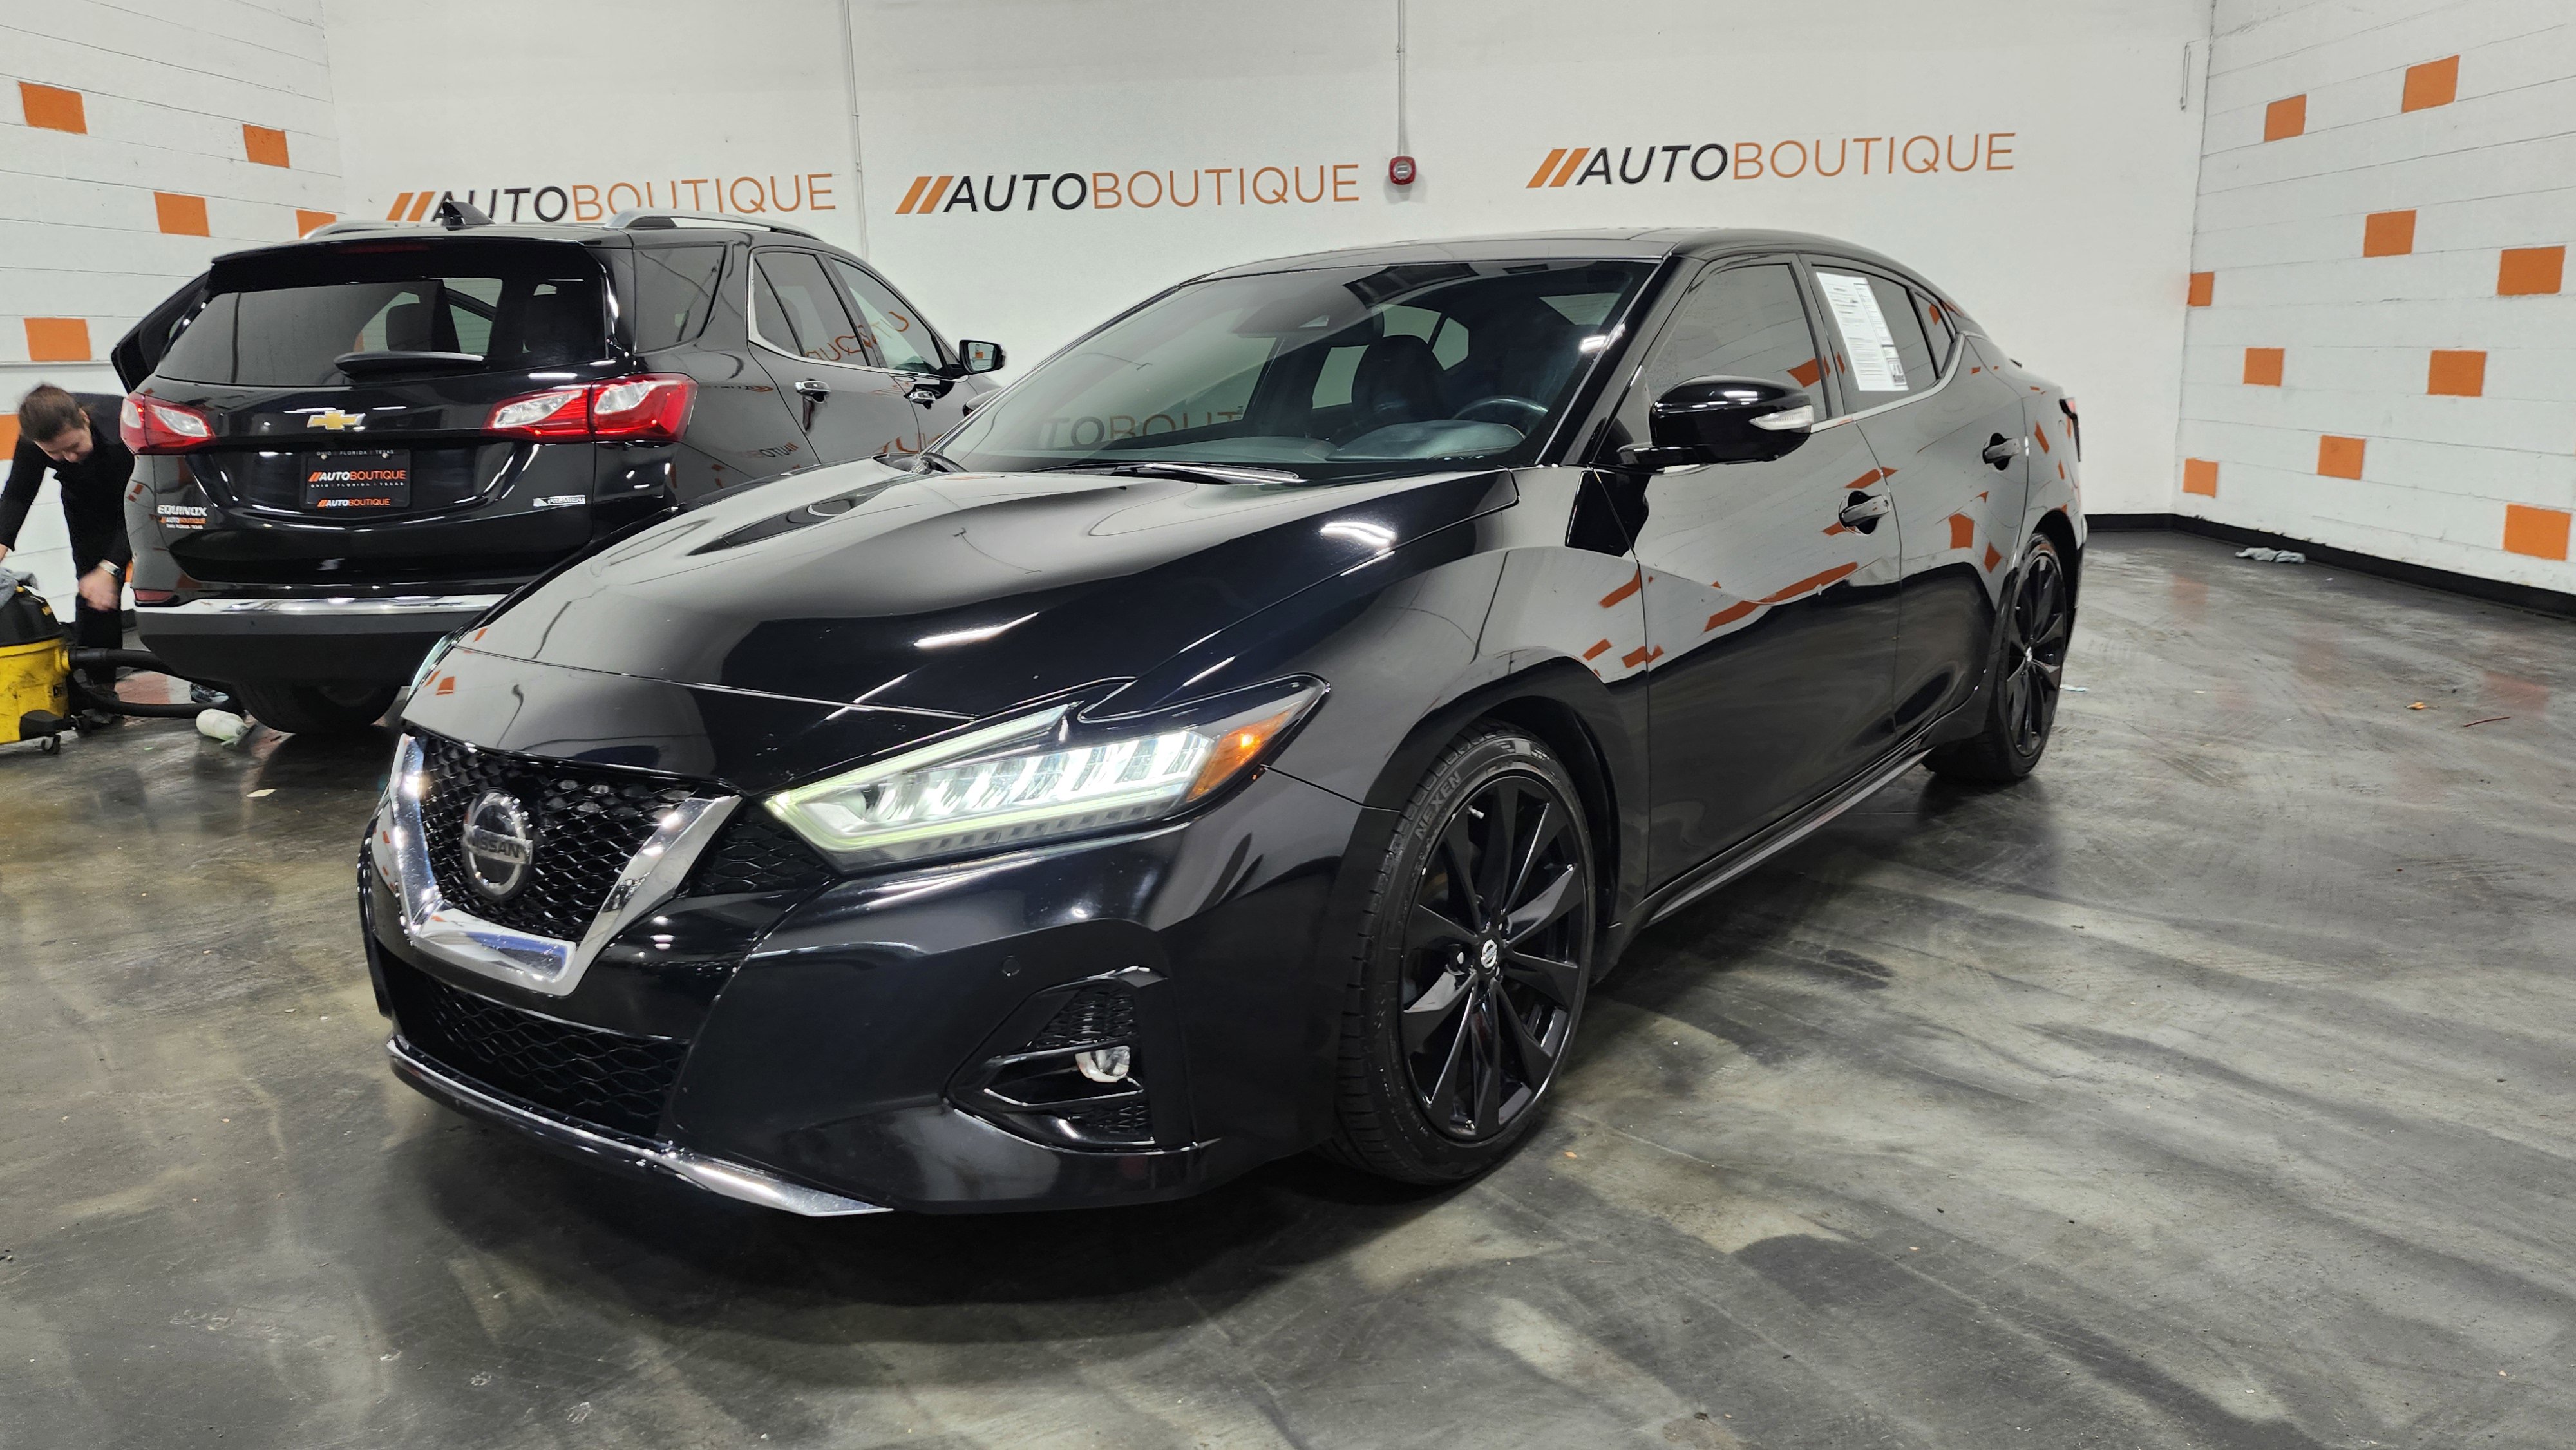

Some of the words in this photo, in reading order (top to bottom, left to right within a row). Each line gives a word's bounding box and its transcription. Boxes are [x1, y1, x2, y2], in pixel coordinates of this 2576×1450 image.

[1576, 133, 2016, 185] AUTOBOUTIQUE
[942, 164, 1360, 212] AUTOBOUTIQUE
[319, 470, 406, 482] AUTOBOUTIQUE
[158, 505, 207, 516] EQUINOX
[326, 498, 391, 507] AUTOBOUTIQUE
[1414, 771, 1461, 840] NEXEN
